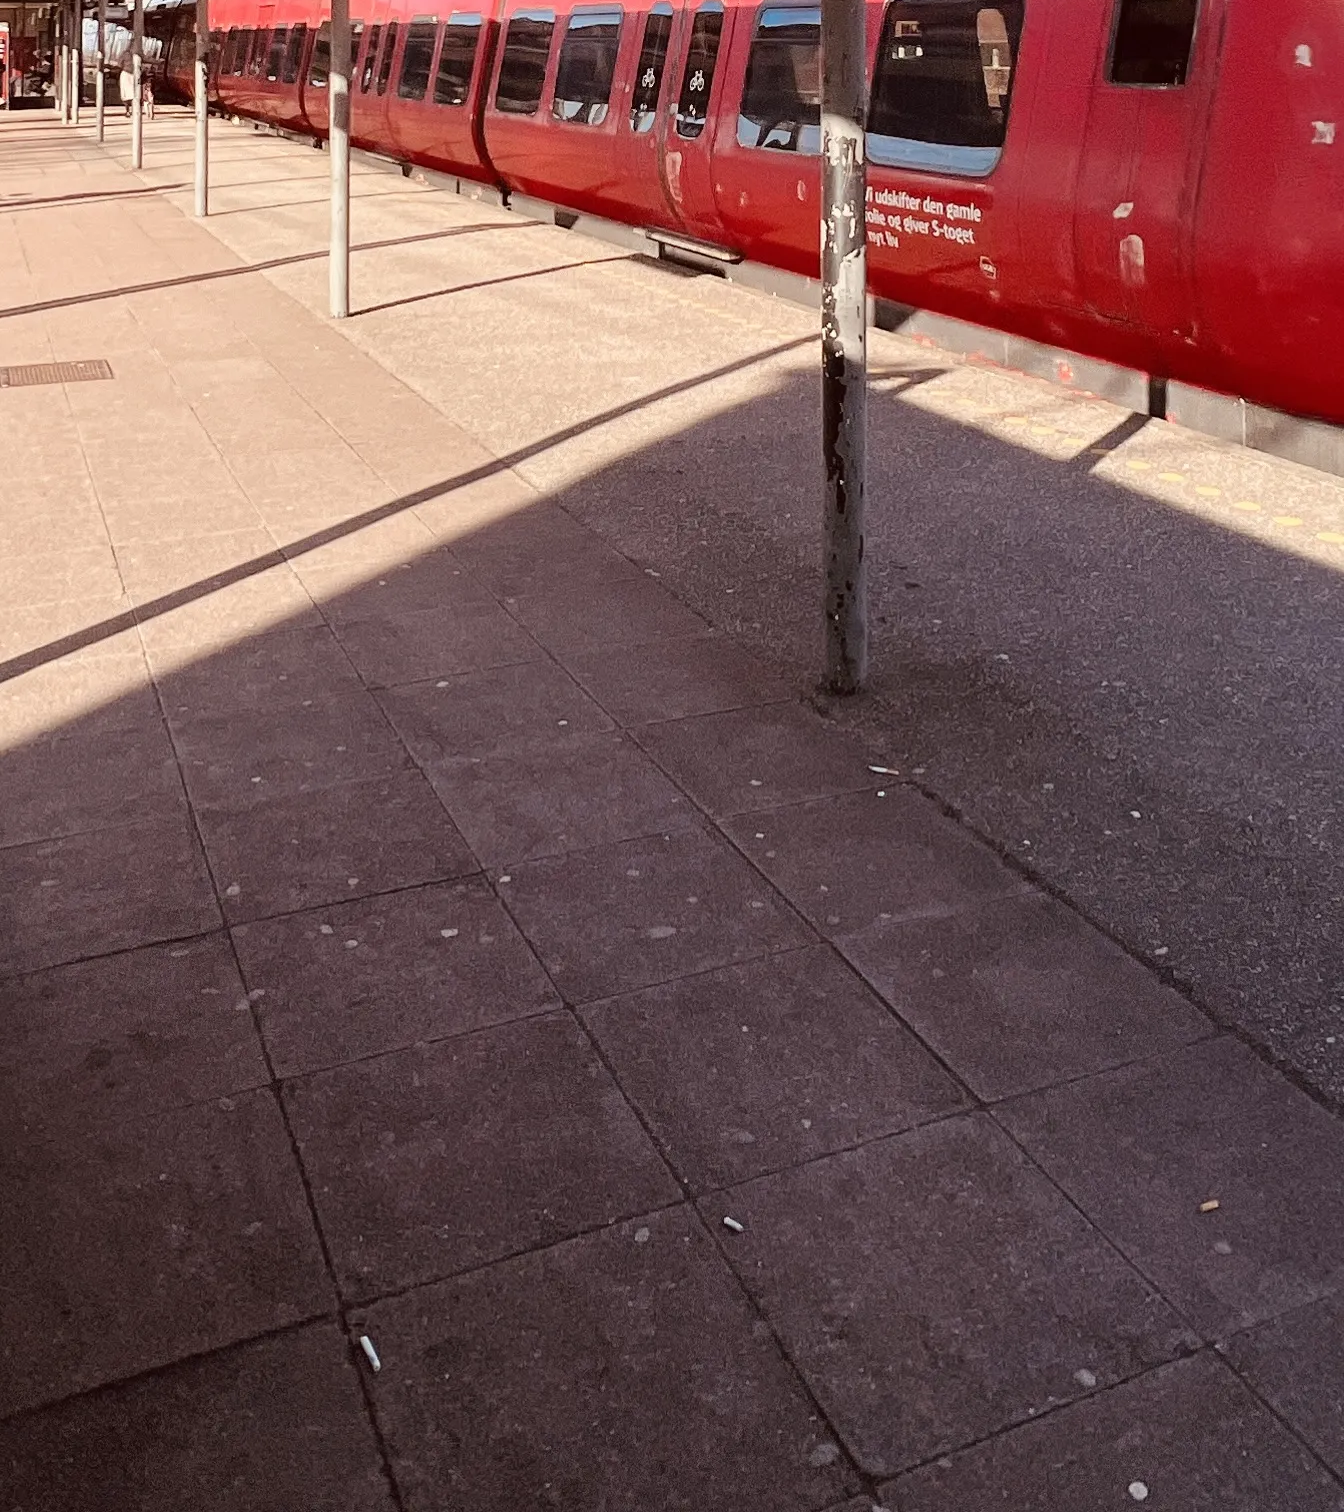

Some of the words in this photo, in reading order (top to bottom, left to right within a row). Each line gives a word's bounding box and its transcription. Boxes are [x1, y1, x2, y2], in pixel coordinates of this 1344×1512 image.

[875, 188, 922, 211] udskifter
[922, 195, 944, 215] den
[945, 202, 982, 223] gamle
[884, 230, 900, 248] liv
[887, 214, 902, 233] og
[902, 214, 931, 235] giver
[931, 219, 976, 245] S-toget
